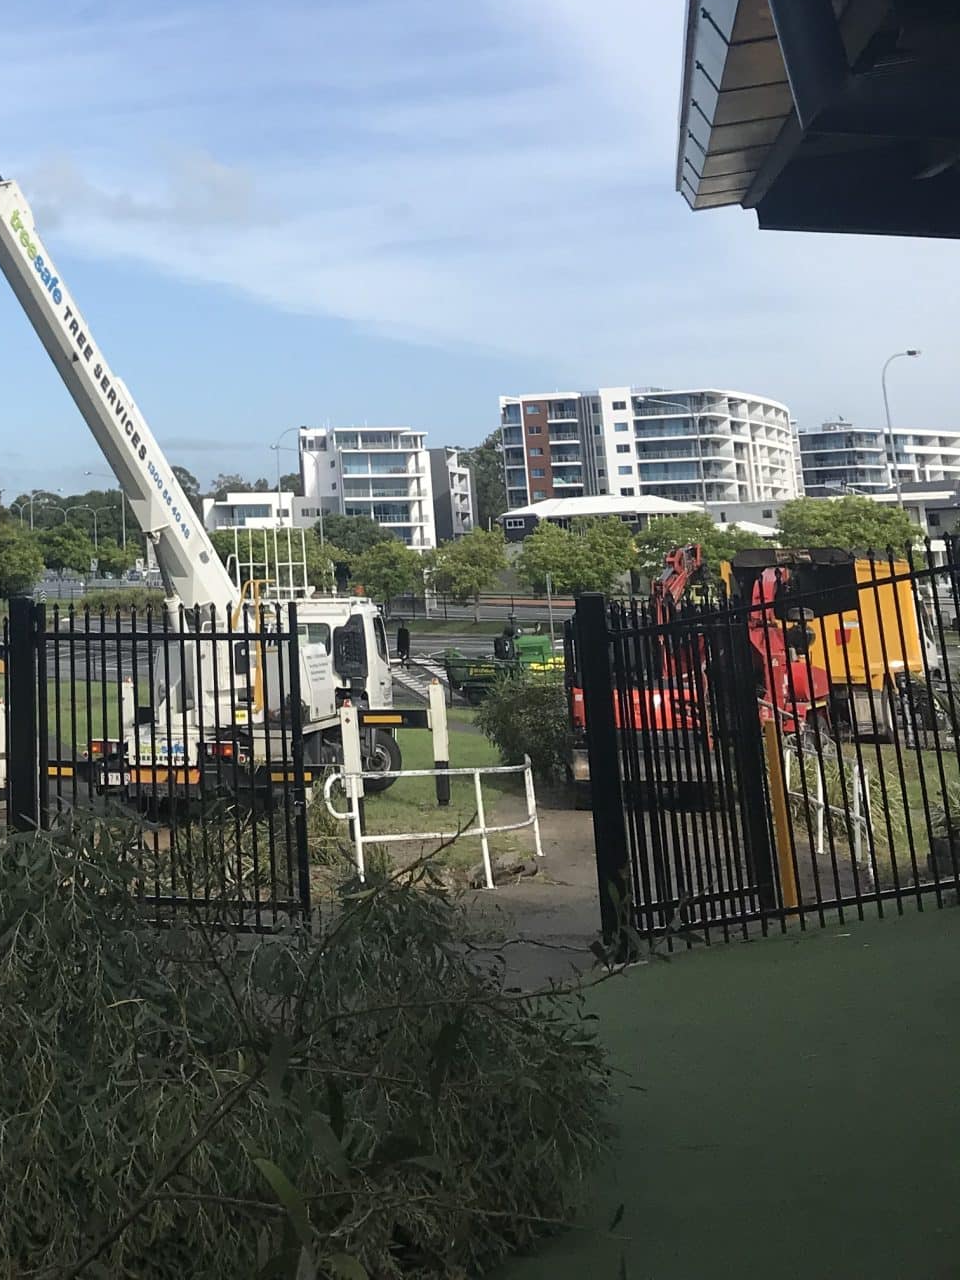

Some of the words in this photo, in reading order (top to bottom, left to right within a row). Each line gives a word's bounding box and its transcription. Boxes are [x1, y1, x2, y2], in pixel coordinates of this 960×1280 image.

[10, 209, 62, 305] treesafe
[63, 306, 94, 362] TREE
[94, 363, 147, 461] SERVICES
[147, 461, 163, 489] 1300
